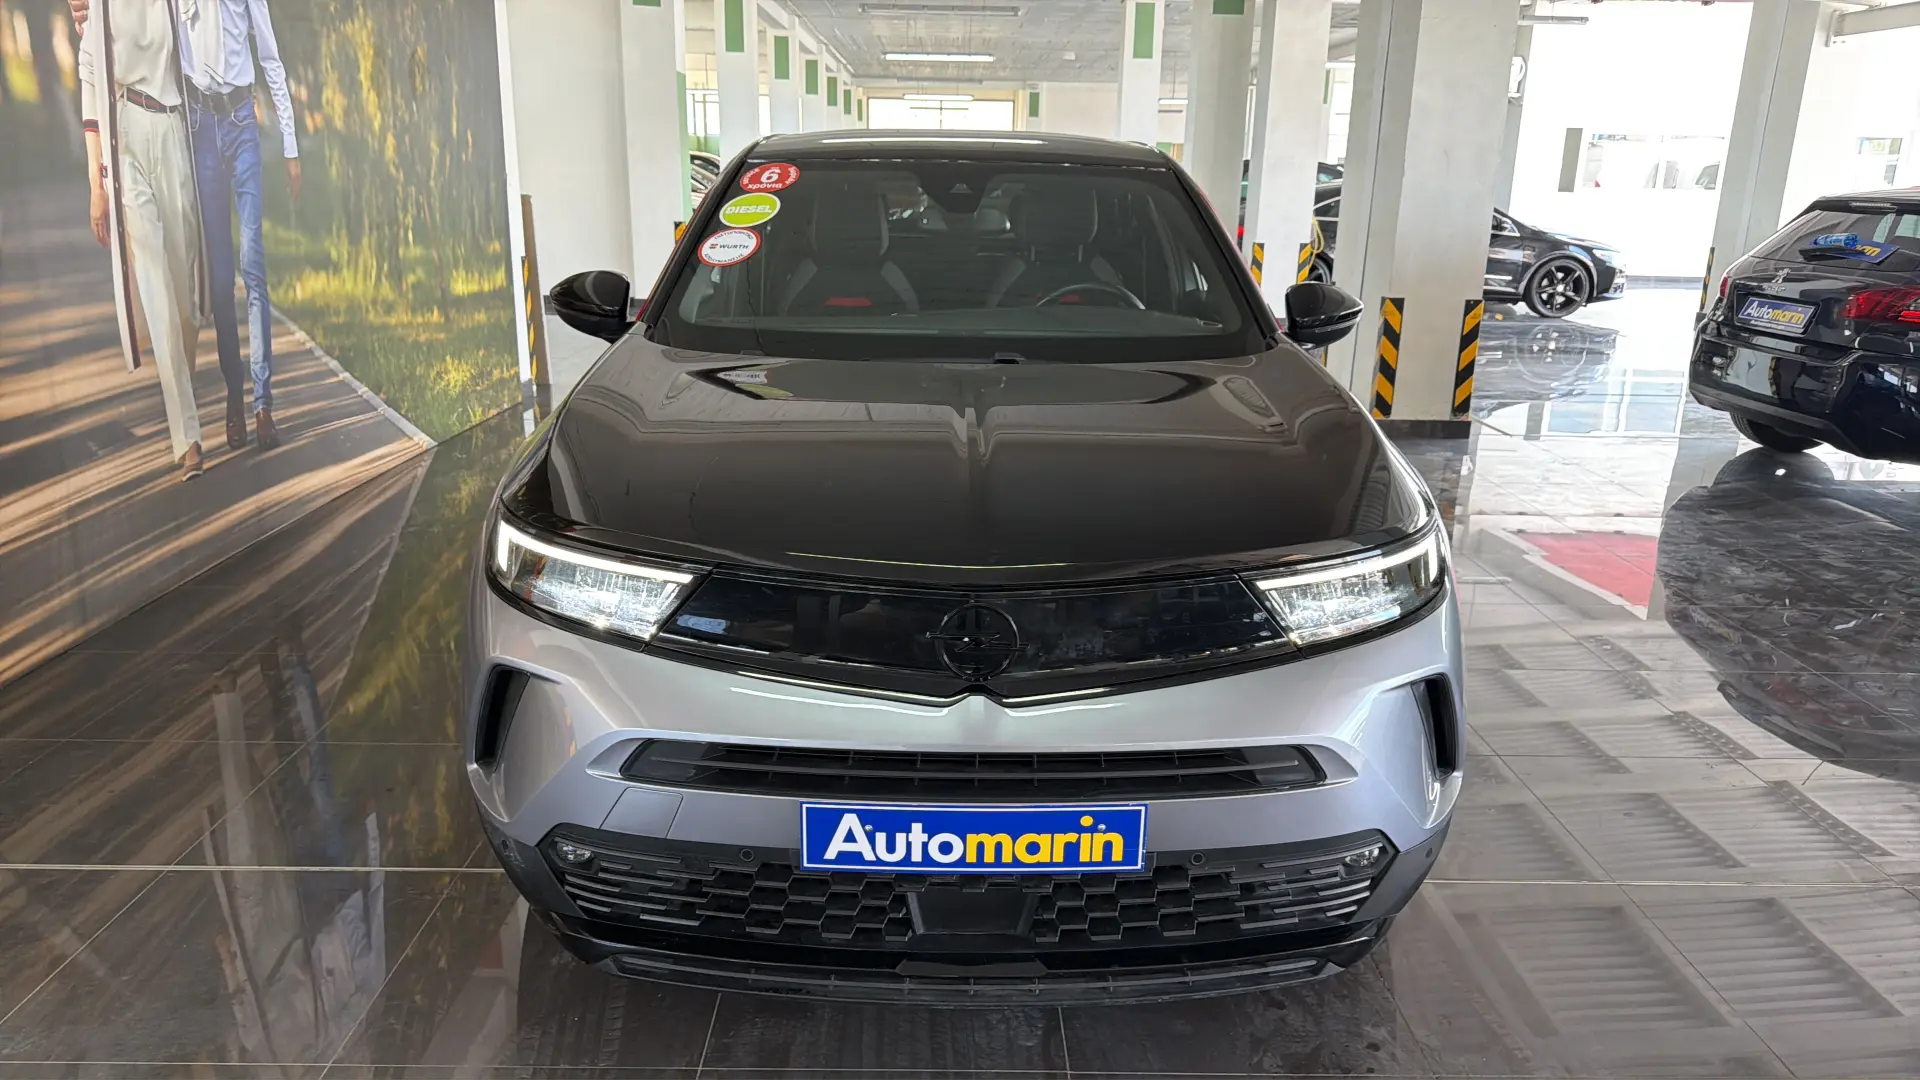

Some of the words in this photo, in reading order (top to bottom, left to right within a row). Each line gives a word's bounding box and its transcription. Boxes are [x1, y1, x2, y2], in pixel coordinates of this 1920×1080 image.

[760, 169, 782, 183] 6
[725, 205, 773, 214] DIESEL
[1743, 301, 1805, 324] Automarin
[823, 813, 1124, 864] Automarin
